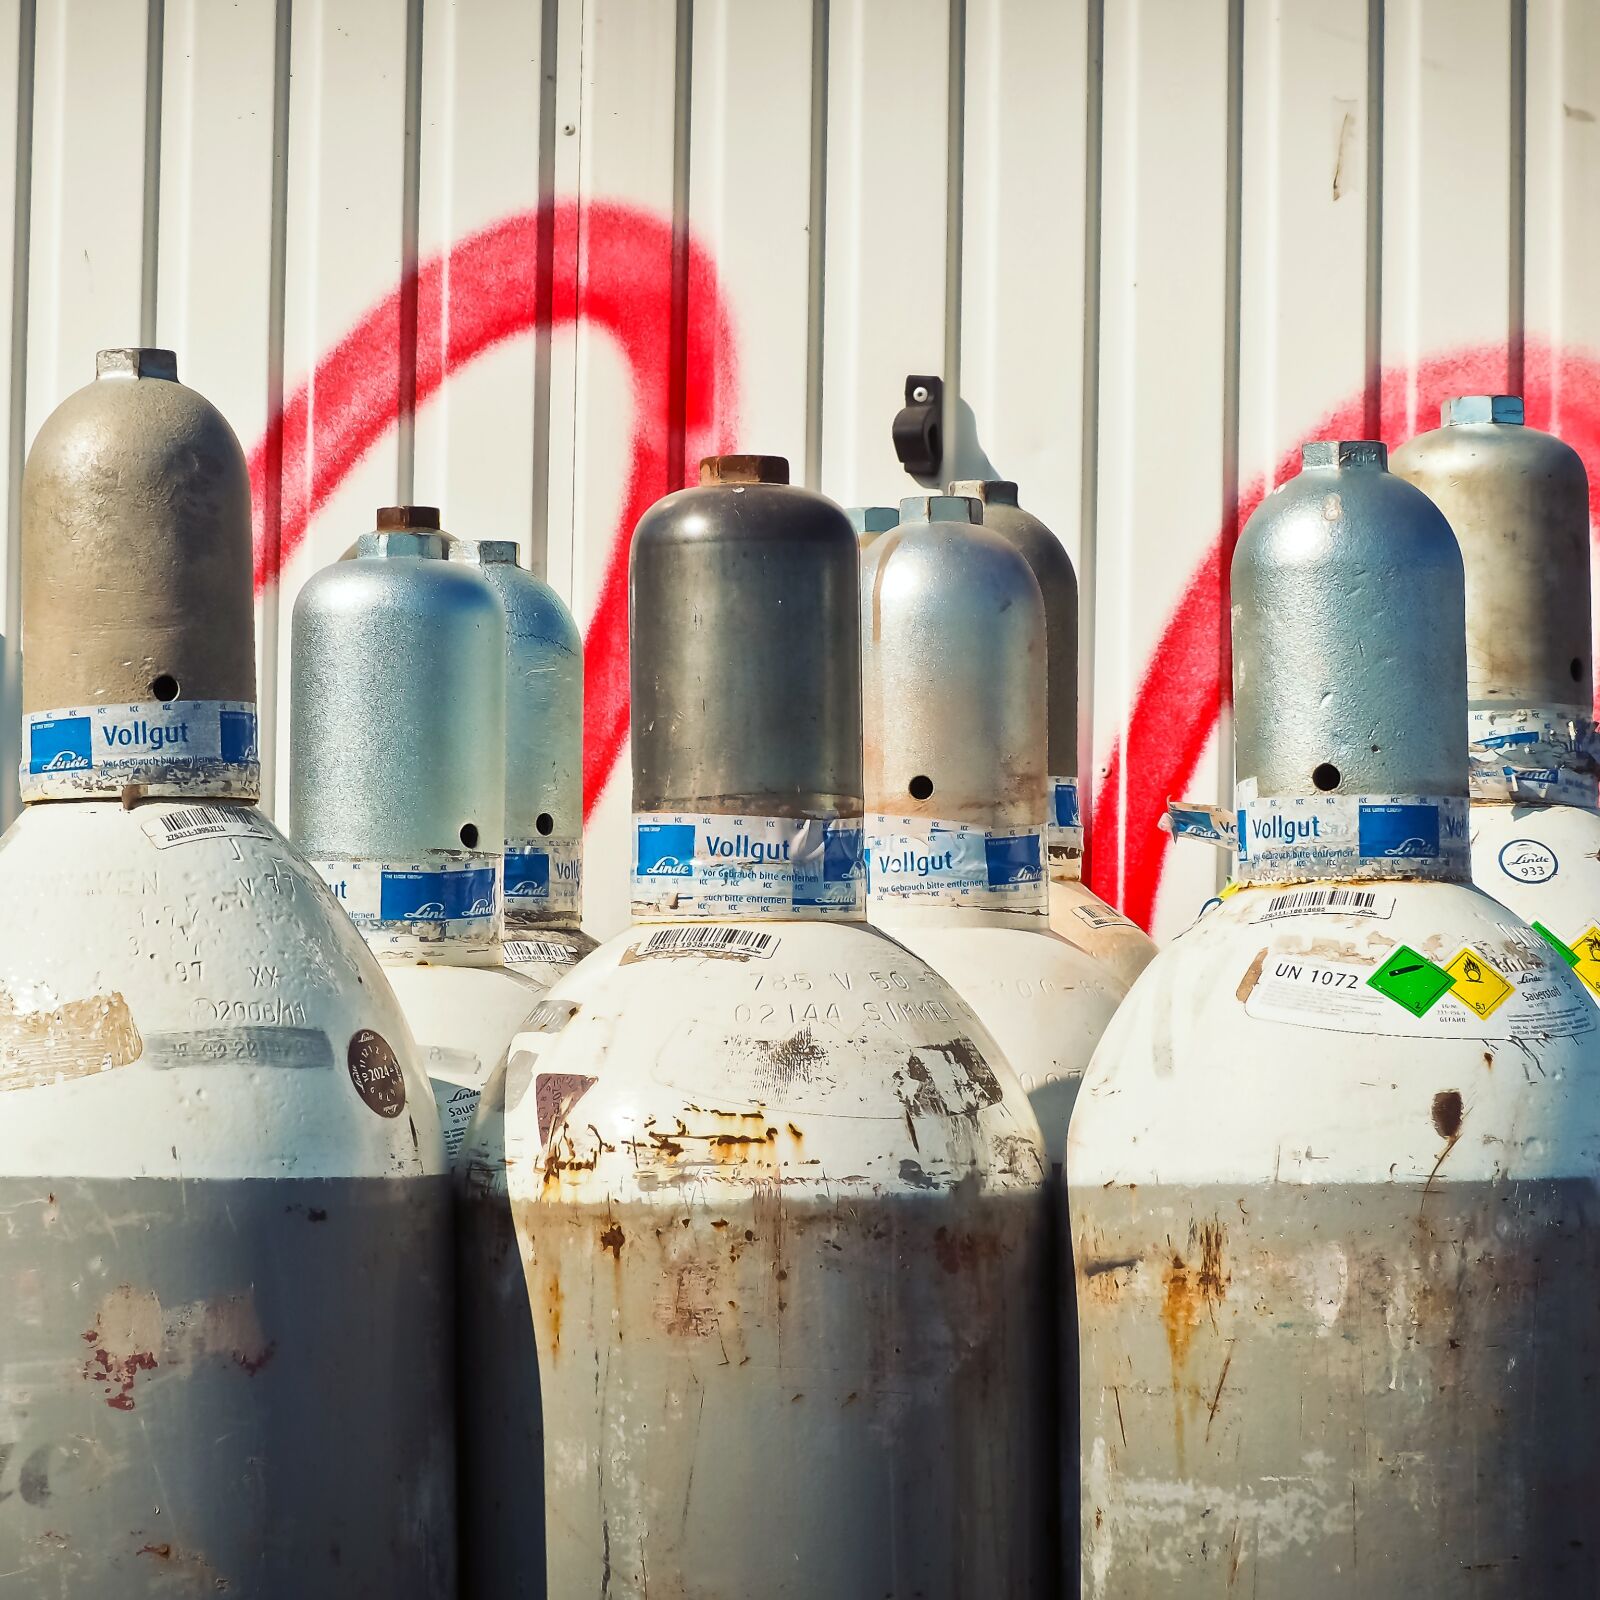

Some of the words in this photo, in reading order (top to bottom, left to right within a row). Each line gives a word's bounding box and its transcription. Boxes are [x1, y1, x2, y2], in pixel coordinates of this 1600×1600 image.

[102, 720, 189, 750] Vollgut
[42, 750, 89, 771] Linde
[1326, 797, 1336, 805] ICC
[702, 817, 712, 825] ICC
[766, 820, 775, 828] ICC
[1252, 814, 1321, 844] Vollgut
[706, 834, 790, 865] Vollgut
[1384, 837, 1435, 856] Linde
[646, 855, 689, 874] Linde
[879, 850, 953, 877] Vollgut
[1507, 852, 1550, 866] Linde
[702, 869, 716, 878] Vor
[718, 868, 757, 880] Gebrauch
[759, 871, 779, 881] bitte
[781, 873, 819, 883] entfernen
[1521, 866, 1545, 877] 933
[504, 880, 548, 896] Linde
[762, 881, 773, 889] ICC
[890, 882, 925, 893] Gebrauch
[926, 880, 945, 890] bitte
[946, 879, 984, 889] entfernen
[1275, 962, 1303, 980] UN
[1311, 969, 1359, 990] 1072
[1516, 972, 1542, 985] Linde
[1475, 1002, 1486, 1010] 5.1
[368, 1065, 391, 1082] 2024
[446, 1087, 482, 1104] Linde
